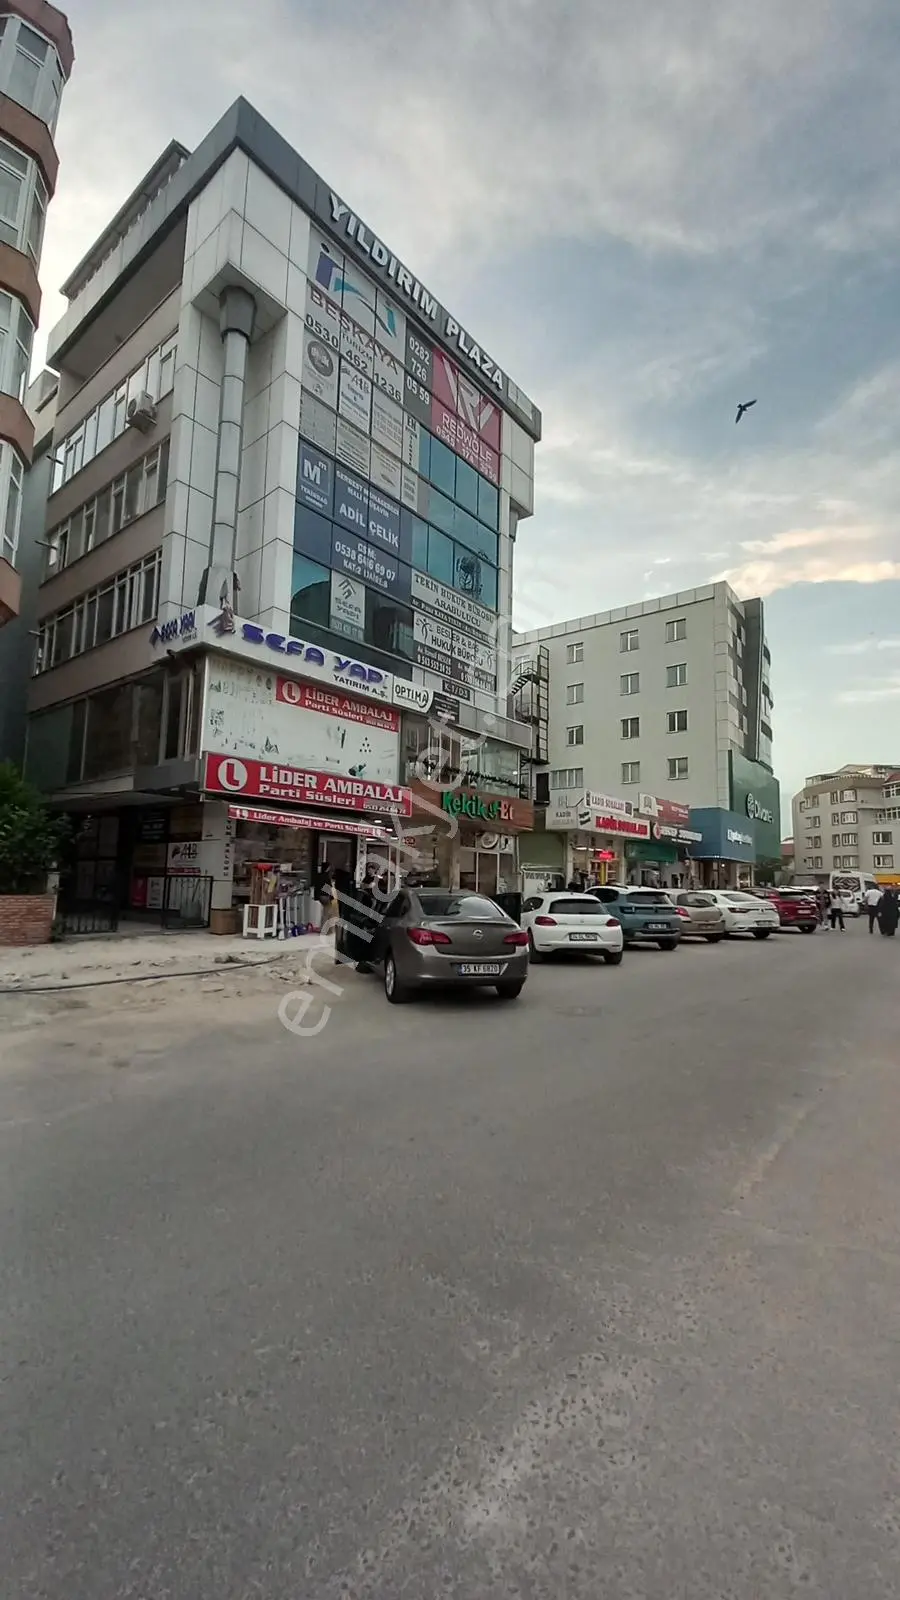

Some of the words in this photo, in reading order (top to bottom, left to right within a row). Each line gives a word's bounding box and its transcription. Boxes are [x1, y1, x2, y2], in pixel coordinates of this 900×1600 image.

[330, 192, 438, 320] YILDIRIM
[446, 317, 503, 391] PLAZA
[306, 313, 339, 348] 0530
[346, 349, 368, 373] 462
[411, 358, 428, 383] 726
[406, 376, 418, 395] 05
[419, 385, 430, 405] 59
[442, 413, 492, 461] REDWOLF
[340, 503, 366, 528] ADİL
[369, 521, 399, 548] ÇELİK
[386, 569, 396, 581] 07
[441, 588, 466, 609] HUKUK
[434, 598, 481, 627] ARABULUCU
[241, 623, 325, 667] SEFA
[431, 634, 456, 655] HUKUK
[333, 674, 370, 692] YATIRIM
[394, 683, 429, 705] OPTIMA
[305, 687, 339, 707] LİDER
[342, 700, 392, 722] AMBALAJ
[305, 700, 331, 713] Parti
[332, 705, 363, 721] Süsleri
[259, 783, 300, 798] Parti
[305, 790, 356, 807] Süsleri
[260, 765, 318, 789] LİDER
[324, 777, 404, 802] AMBALAJ
[253, 811, 276, 822] Lider
[277, 815, 312, 828] Ambalaj
